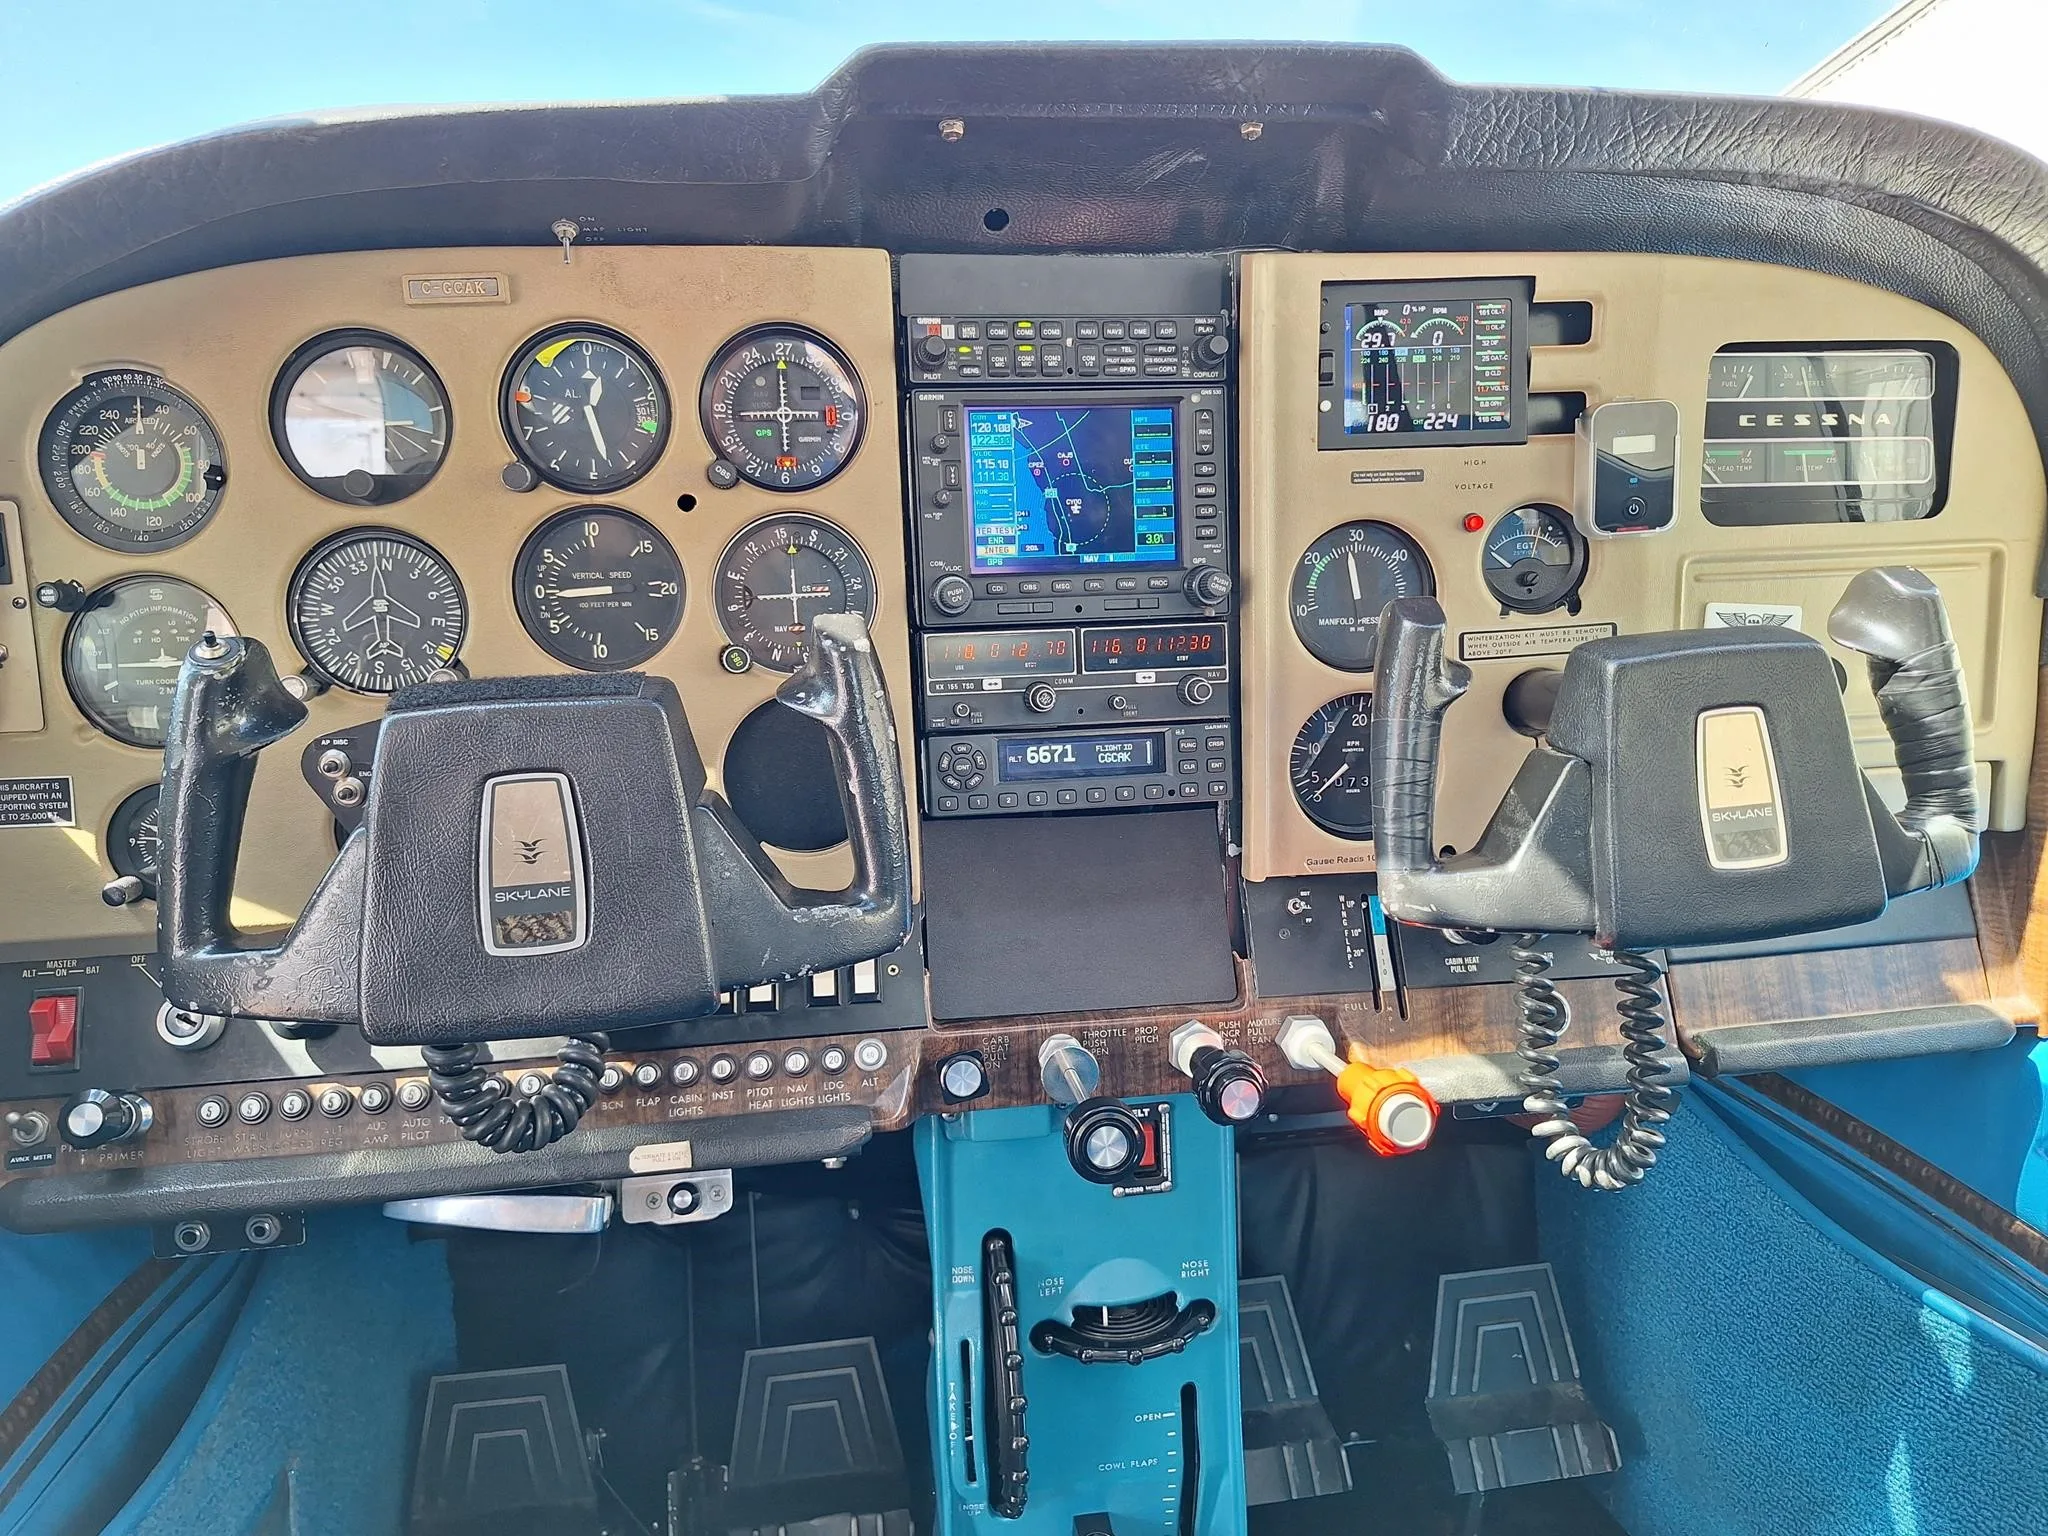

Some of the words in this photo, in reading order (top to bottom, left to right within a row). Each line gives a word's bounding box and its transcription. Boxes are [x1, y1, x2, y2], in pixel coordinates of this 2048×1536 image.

[421, 281, 486, 295] C-GCAK
[1361, 333, 1396, 348] 29.7
[776, 343, 793, 355] 27
[69, 396, 91, 415] PRESS
[1368, 414, 1399, 432] 180
[1424, 413, 1459, 431] 224
[1739, 413, 1891, 427] CESSNA
[756, 429, 772, 437] GPS
[715, 466, 732, 480] OBS
[585, 522, 599, 536] 10
[1349, 530, 1364, 541] 30
[640, 541, 653, 553] 15
[1304, 552, 1321, 565] 20
[1391, 550, 1408, 561] 40
[661, 583, 677, 595] 20
[119, 616, 129, 625] NO
[129, 607, 150, 621] PITCH
[150, 606, 199, 623] INFORMATION
[1297, 605, 1308, 617] 10
[1319, 618, 1354, 626] MANIFOLD
[646, 629, 659, 641] 15
[1541, 637, 1588, 645] TEMPERATURE
[593, 645, 608, 658] 10
[730, 652, 744, 667] OBS
[1352, 714, 1368, 726] 20
[1027, 745, 1076, 764] 6671
[1099, 753, 1131, 763] CGCAK
[13, 783, 49, 791] AIRCRAFT
[0, 803, 36, 811] EPORTING
[1712, 807, 1773, 822] SKYLANE
[1337, 856, 1364, 864] Reads
[494, 886, 571, 903] SKYLANE
[1339, 895, 1348, 926] WING
[1345, 930, 1354, 969] FLAPS
[46, 960, 78, 969] MASTER
[131, 956, 146, 964] OFF
[1445, 957, 1463, 966] CABIN
[1465, 956, 1480, 965] HEAT
[22, 970, 37, 978] ALT
[56, 969, 67, 977] ON
[86, 966, 100, 975] BAT
[1451, 965, 1467, 974] PULL
[1219, 1021, 1240, 1029] PUSH
[1248, 1018, 1282, 1027] MIXTURE
[1083, 1029, 1128, 1039] THROTTLE
[1135, 1026, 1158, 1035] PROP
[1220, 1030, 1240, 1038] INCR
[1248, 1028, 1266, 1036] PULL
[982, 1036, 1010, 1046] CARB
[1083, 1039, 1107, 1048] PUSH
[1135, 1035, 1159, 1044] PITCH
[983, 1044, 1010, 1054] HEAT
[984, 1053, 1007, 1061] PULL
[985, 1061, 1000, 1070] ON
[824, 1081, 845, 1091] LDG
[862, 1077, 879, 1087] ALT
[747, 1087, 774, 1098] PITOT
[787, 1084, 808, 1094] NAV
[670, 1094, 703, 1104] CABIN
[712, 1090, 735, 1101] INST
[818, 1093, 851, 1104] LIGHTS
[602, 1101, 624, 1111] BCN
[636, 1097, 661, 1107] FLAP
[749, 1100, 774, 1110] HEAT
[782, 1096, 815, 1108] LIGHTS
[669, 1106, 704, 1118] LIGHTS
[1132, 1108, 1150, 1117] ELT
[402, 1118, 431, 1128] AUTO
[185, 1135, 224, 1146] STROBE
[364, 1134, 389, 1145] AMP
[401, 1131, 431, 1141] PILOT
[10, 1155, 30, 1164] AVNX
[100, 1151, 144, 1163] PRIMER
[1182, 1260, 1209, 1270] NOSE
[952, 1266, 974, 1275] NOSE
[1181, 1268, 1210, 1279] RIGHT
[952, 1274, 975, 1284] DOWN
[1040, 1286, 1063, 1297] LEFT
[1135, 1412, 1162, 1423] OPEN
[1098, 1461, 1126, 1472] COWL
[1131, 1458, 1159, 1469] FLAPS
[962, 1503, 985, 1512] NOSE
